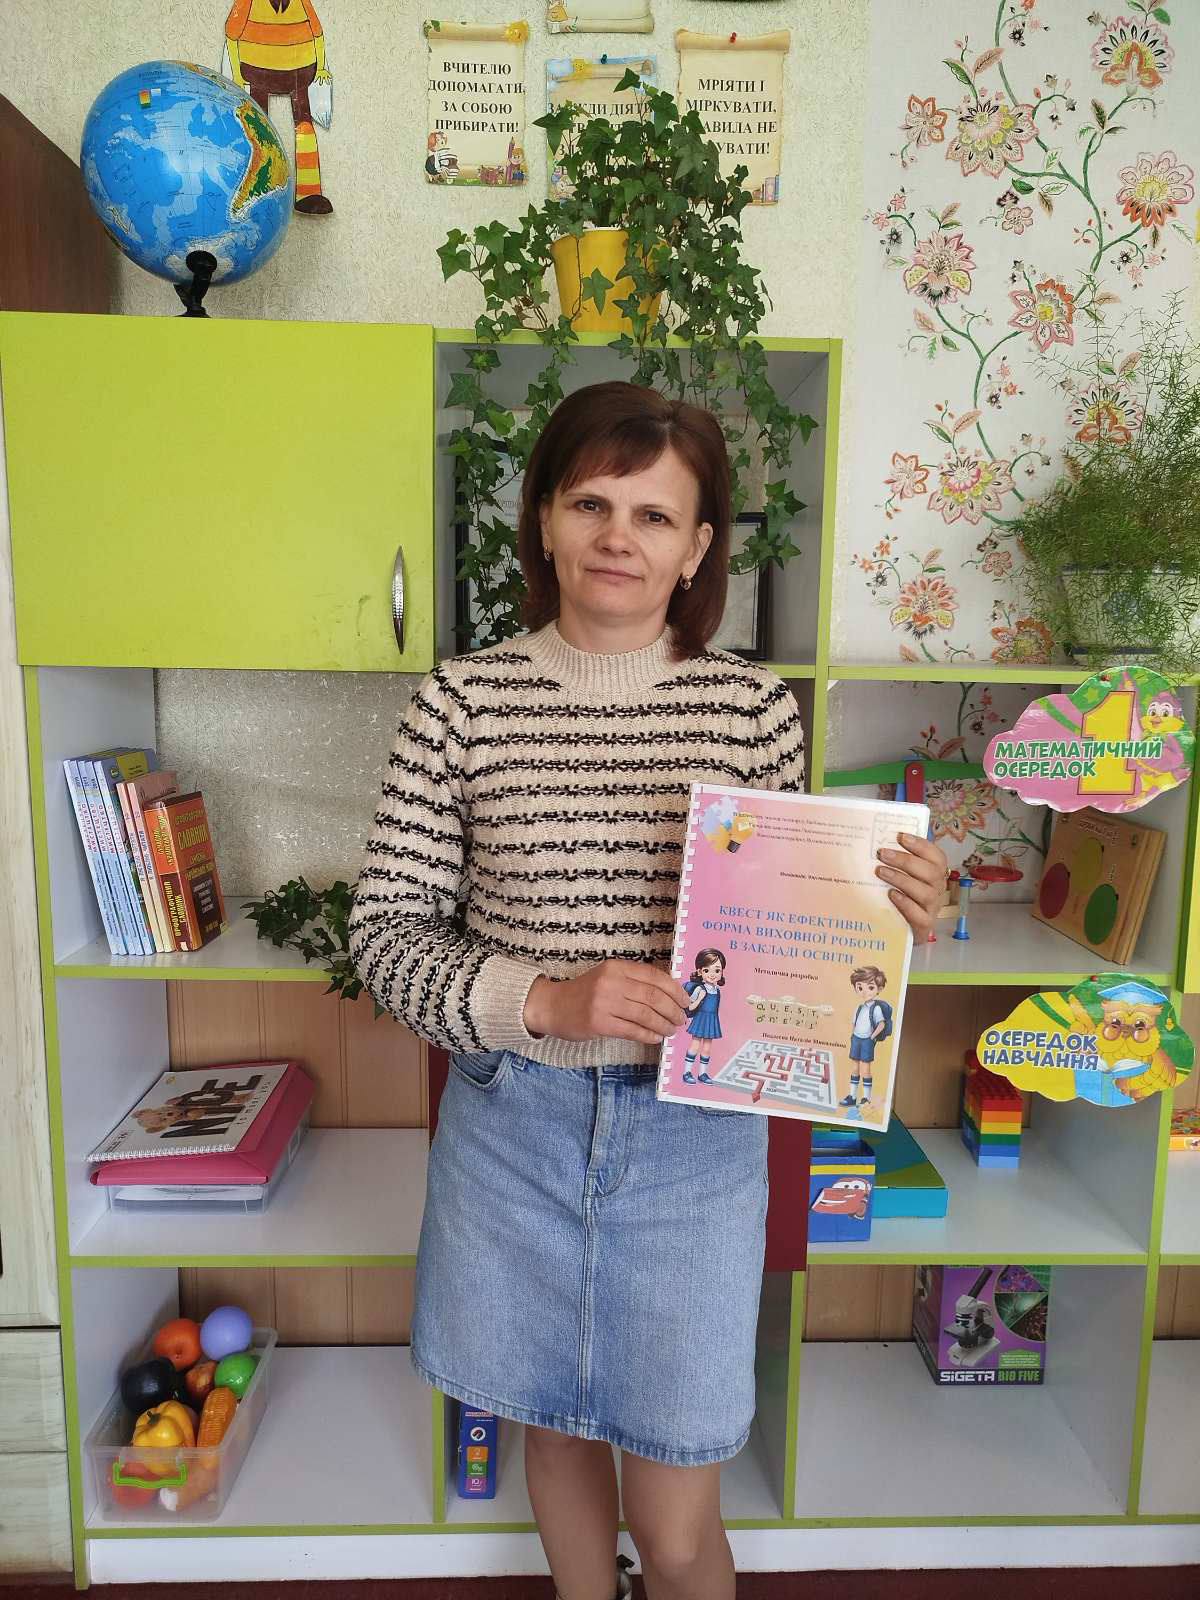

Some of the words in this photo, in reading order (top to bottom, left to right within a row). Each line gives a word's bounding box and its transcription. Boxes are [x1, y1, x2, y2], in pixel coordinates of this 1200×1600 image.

[443, 61, 512, 75] ВЧИТЕЛЮ
[428, 79, 526, 95] ДОПОМАГАТИ,
[698, 79, 756, 92] МРІЯТИ
[760, 80, 765, 92] І
[441, 101, 458, 112] ЗА
[461, 102, 513, 114] СОБОЮ
[686, 99, 777, 113] МІРКУВАТИ,
[435, 119, 519, 133] ПРИБИРАТИ!
[704, 121, 752, 133] АВИЛА
[757, 122, 777, 133] НЕ
[994, 737, 1163, 760] МАТЕМАТИЧНИЙ
[1077, 690, 1136, 795] 1
[993, 760, 1098, 780] ОСЕРЕДОК
[719, 905, 763, 920] КВЕСТ
[766, 911, 785, 922] ЯК
[788, 914, 873, 933] ЕФЕКТИВНА
[702, 920, 751, 935] ФОРМА
[755, 927, 828, 944] ВИХОВНОЇ
[831, 935, 886, 951] РОБОТИ
[729, 939, 738, 950] В
[742, 940, 799, 959] ЗАКЛАДІ
[802, 950, 854, 965] ОСВІТИ
[984, 1030, 1098, 1052] ОСЕРЕДОК
[983, 1049, 1099, 1071] НАВЧАННЯ
[1018, 1370, 1040, 1382] FIVE
